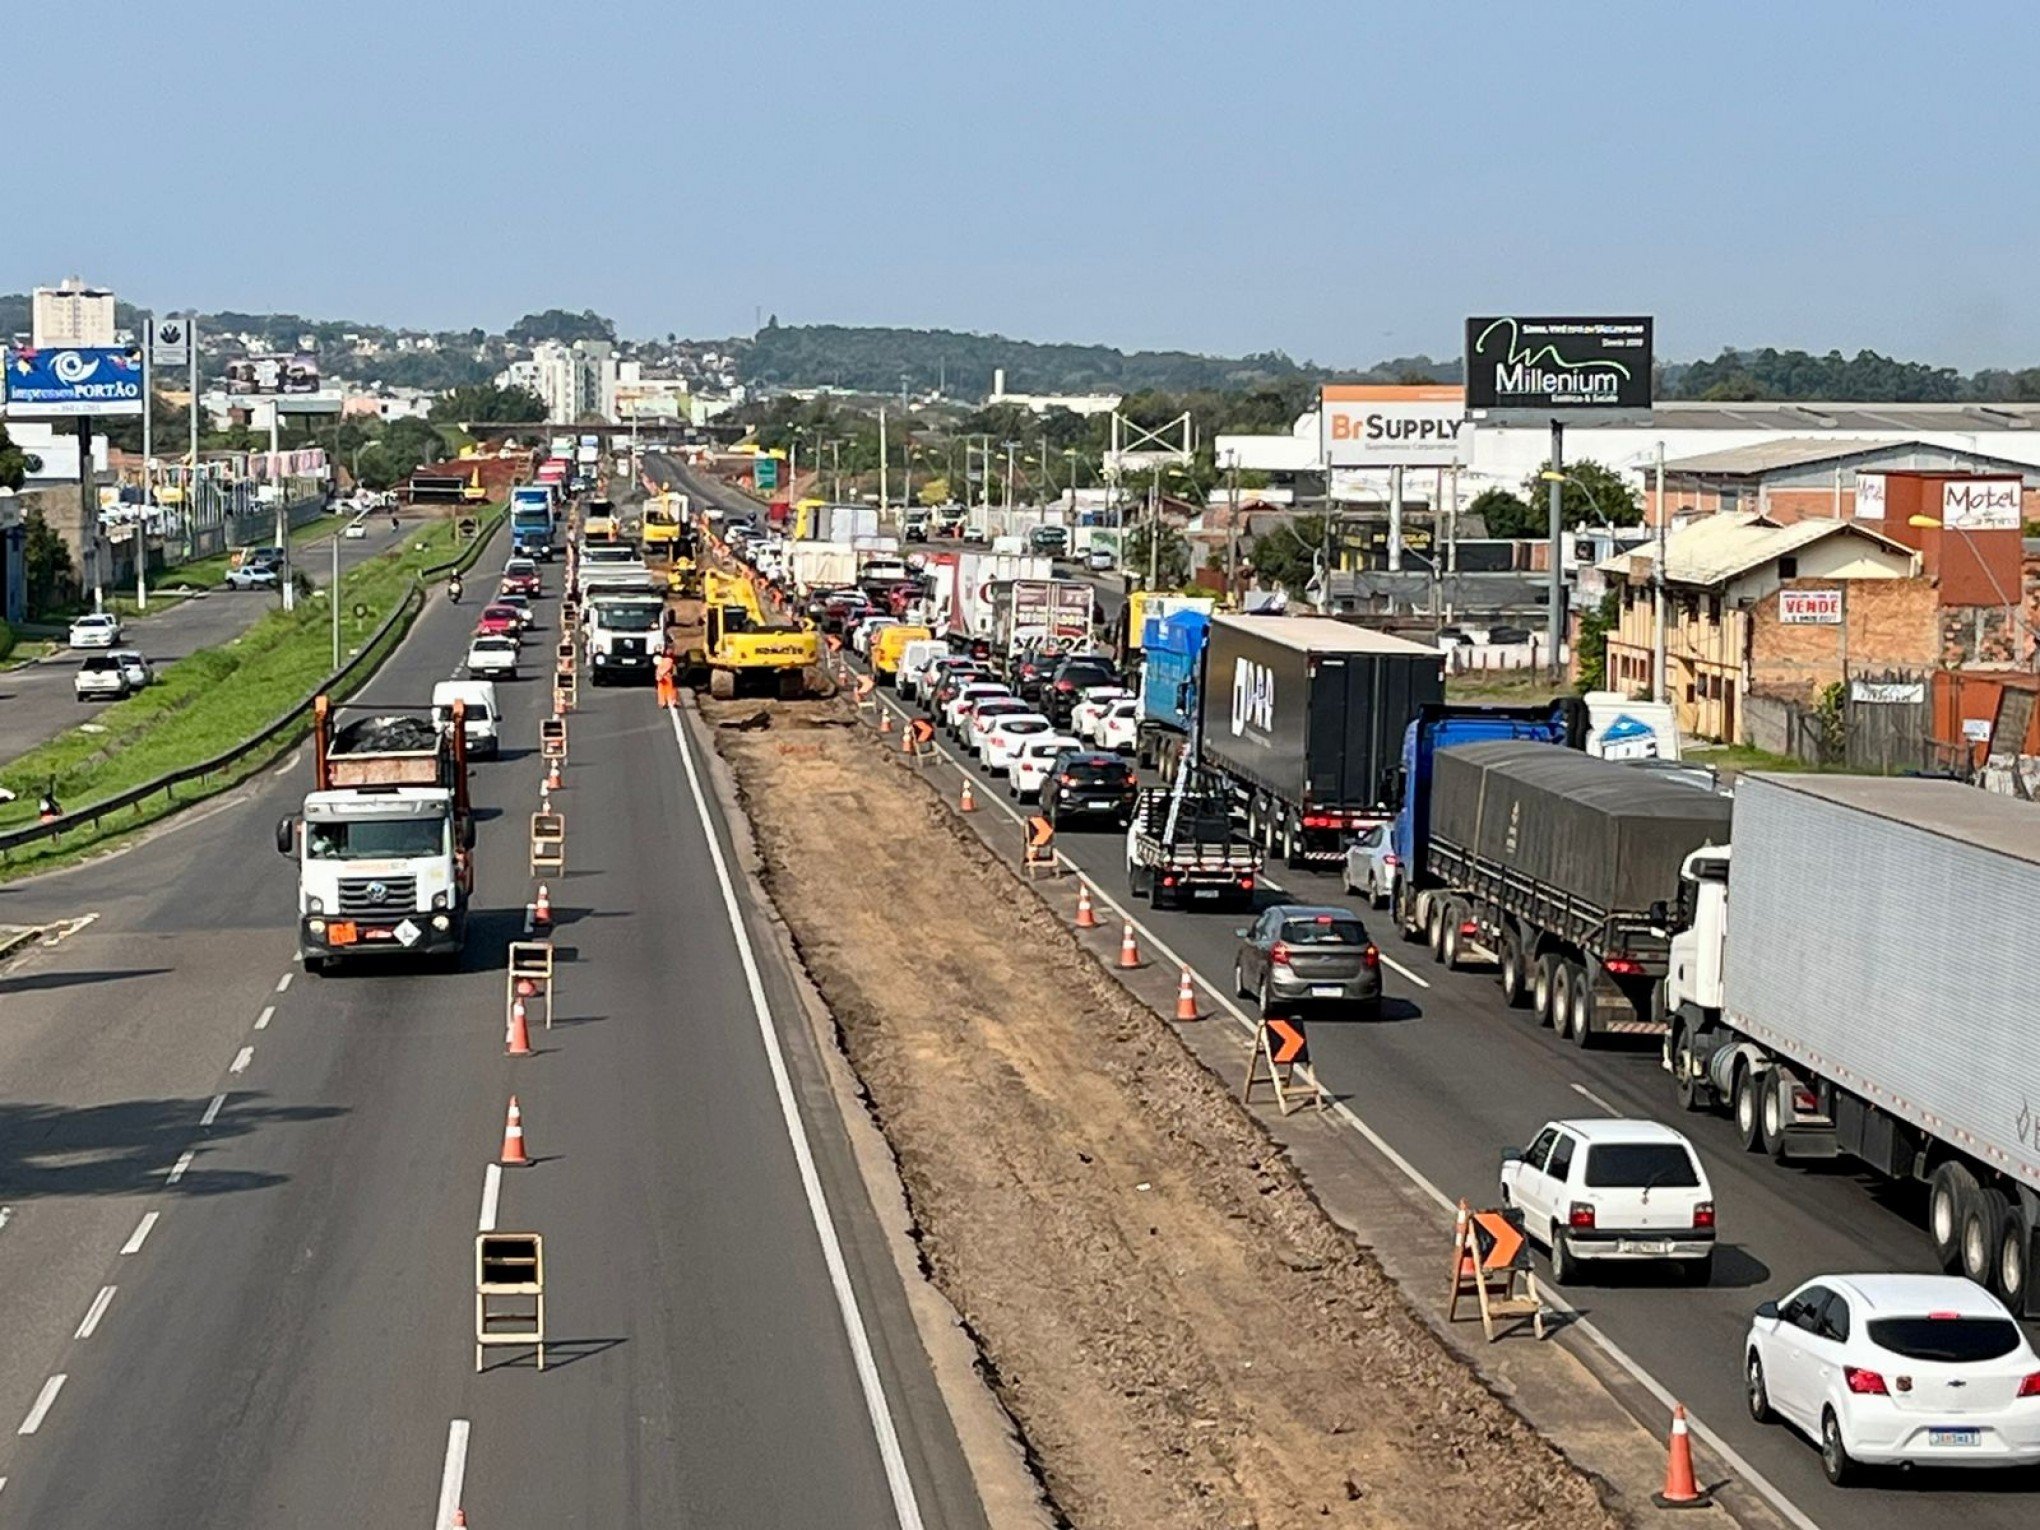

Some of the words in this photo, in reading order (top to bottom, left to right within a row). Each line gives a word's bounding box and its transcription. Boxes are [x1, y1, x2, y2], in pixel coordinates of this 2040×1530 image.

[1496, 363, 1617, 392] Millenium
[1946, 486, 2018, 514] Motel
[1785, 601, 1837, 613] VENDE
